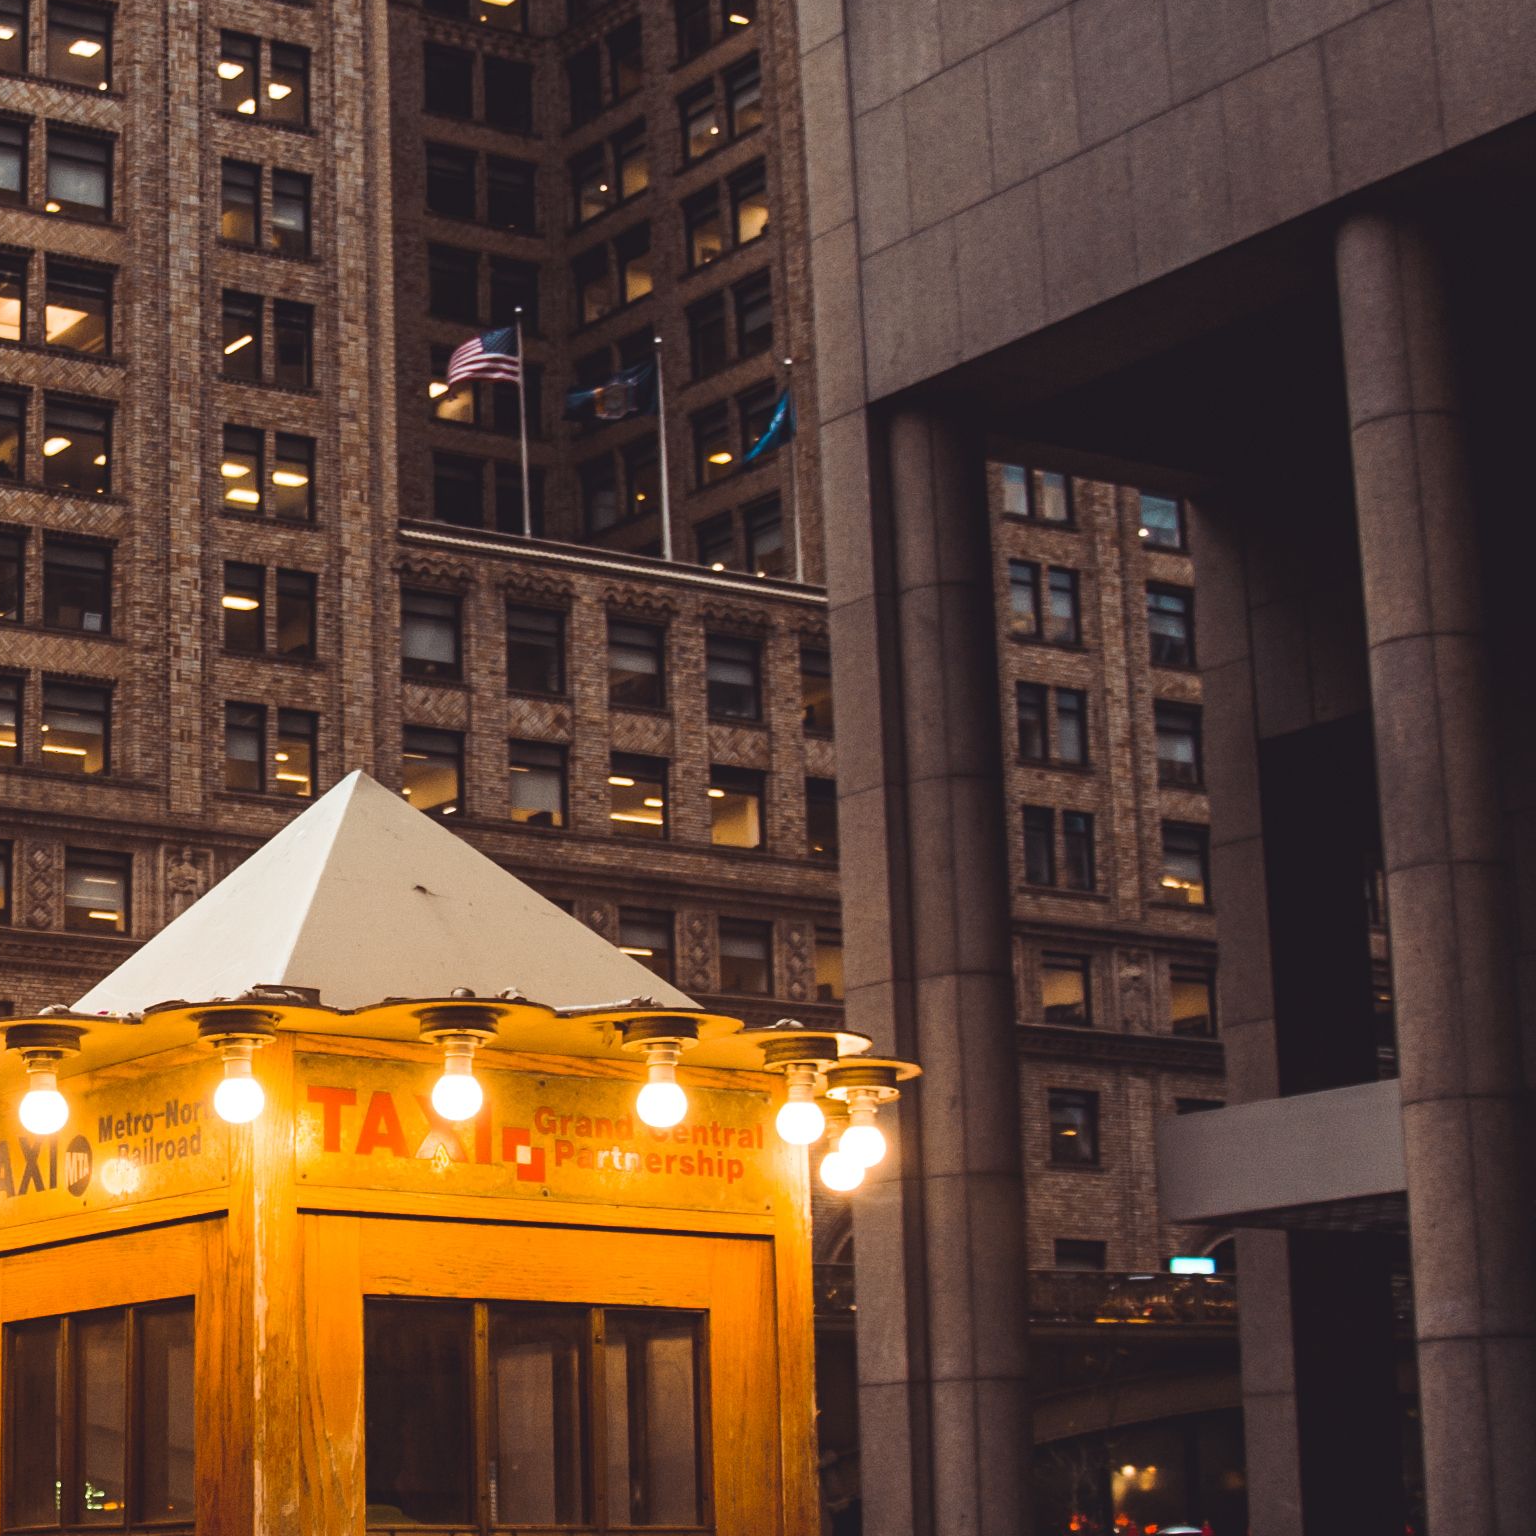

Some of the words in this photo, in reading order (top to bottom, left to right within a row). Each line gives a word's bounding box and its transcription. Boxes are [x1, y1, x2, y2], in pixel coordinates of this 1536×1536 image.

[98, 1095, 213, 1143] Metro-Nor
[307, 1085, 493, 1165] TAXI
[534, 1105, 634, 1140] Grand
[66, 1151, 89, 1186] MTA
[554, 1139, 744, 1184] Partnership
